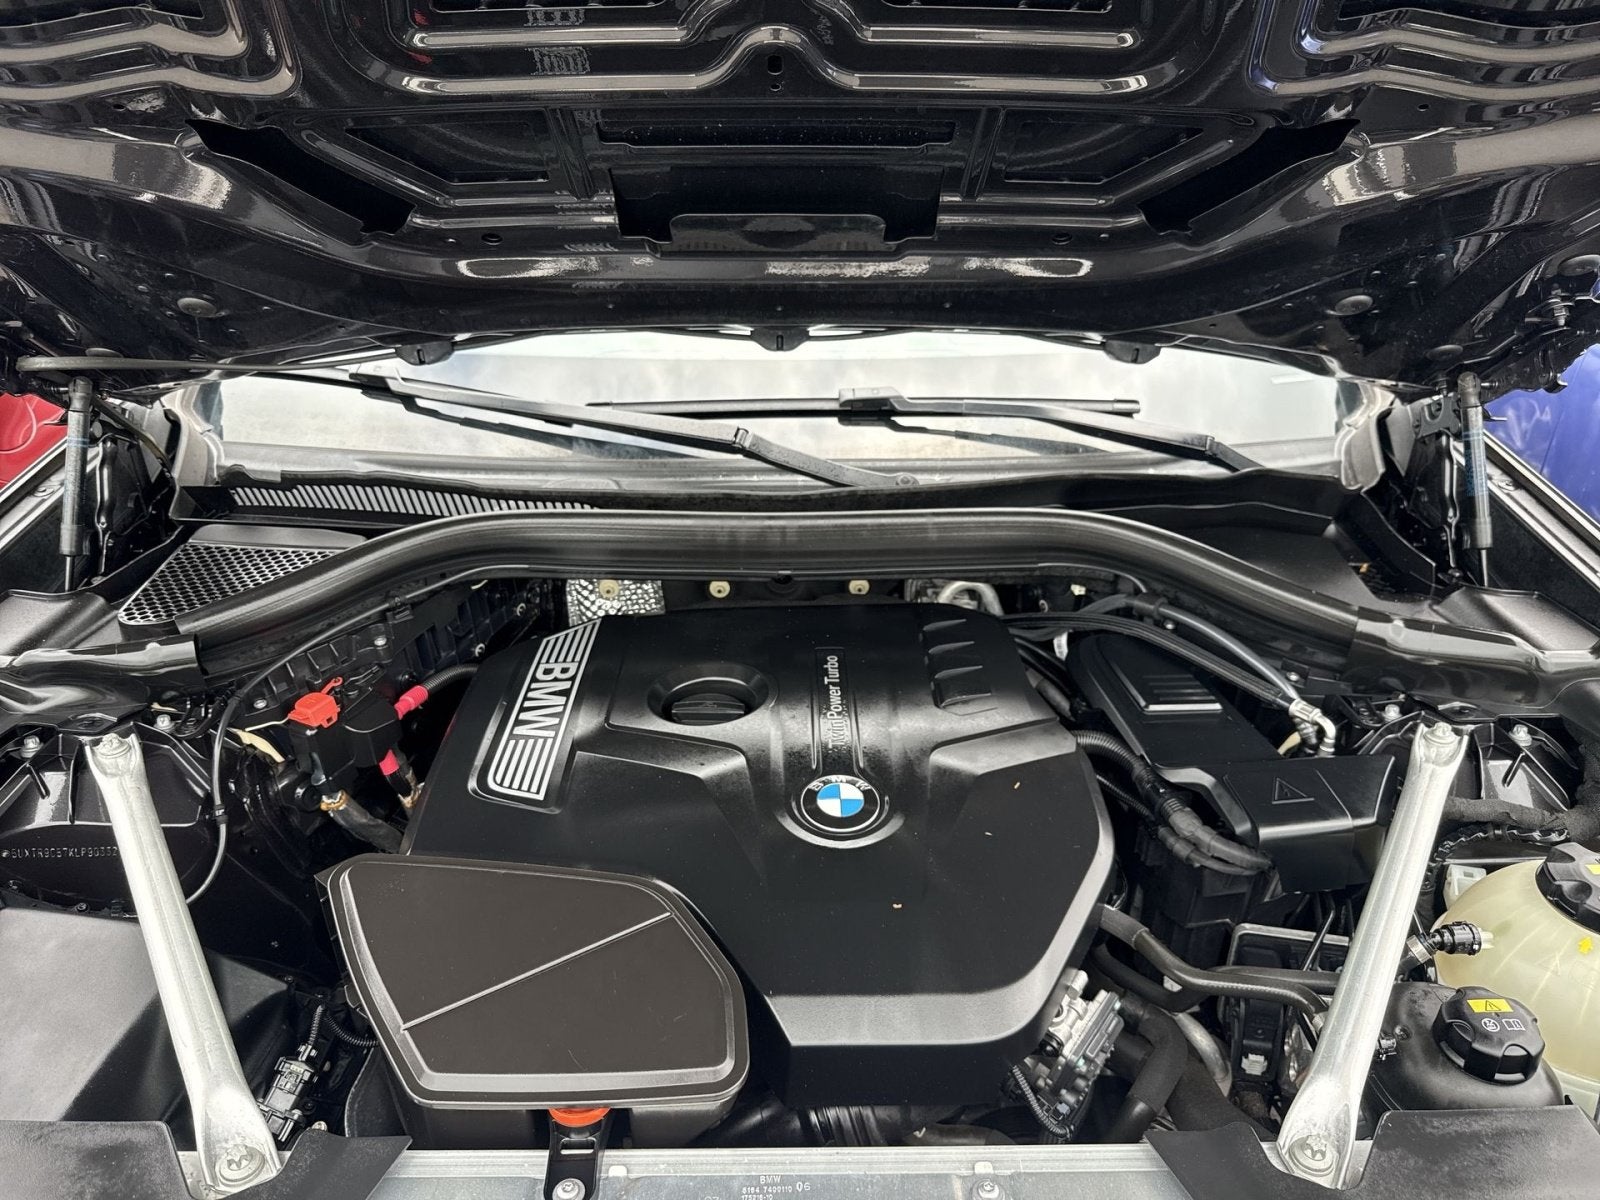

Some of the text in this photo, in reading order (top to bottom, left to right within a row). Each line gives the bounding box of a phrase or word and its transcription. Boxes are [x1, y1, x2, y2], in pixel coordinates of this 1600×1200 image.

[823, 655, 840, 685] Turbo
[513, 662, 579, 737] BMW
[807, 776, 872, 791] BMW
[760, 1175, 781, 1184] BMW
